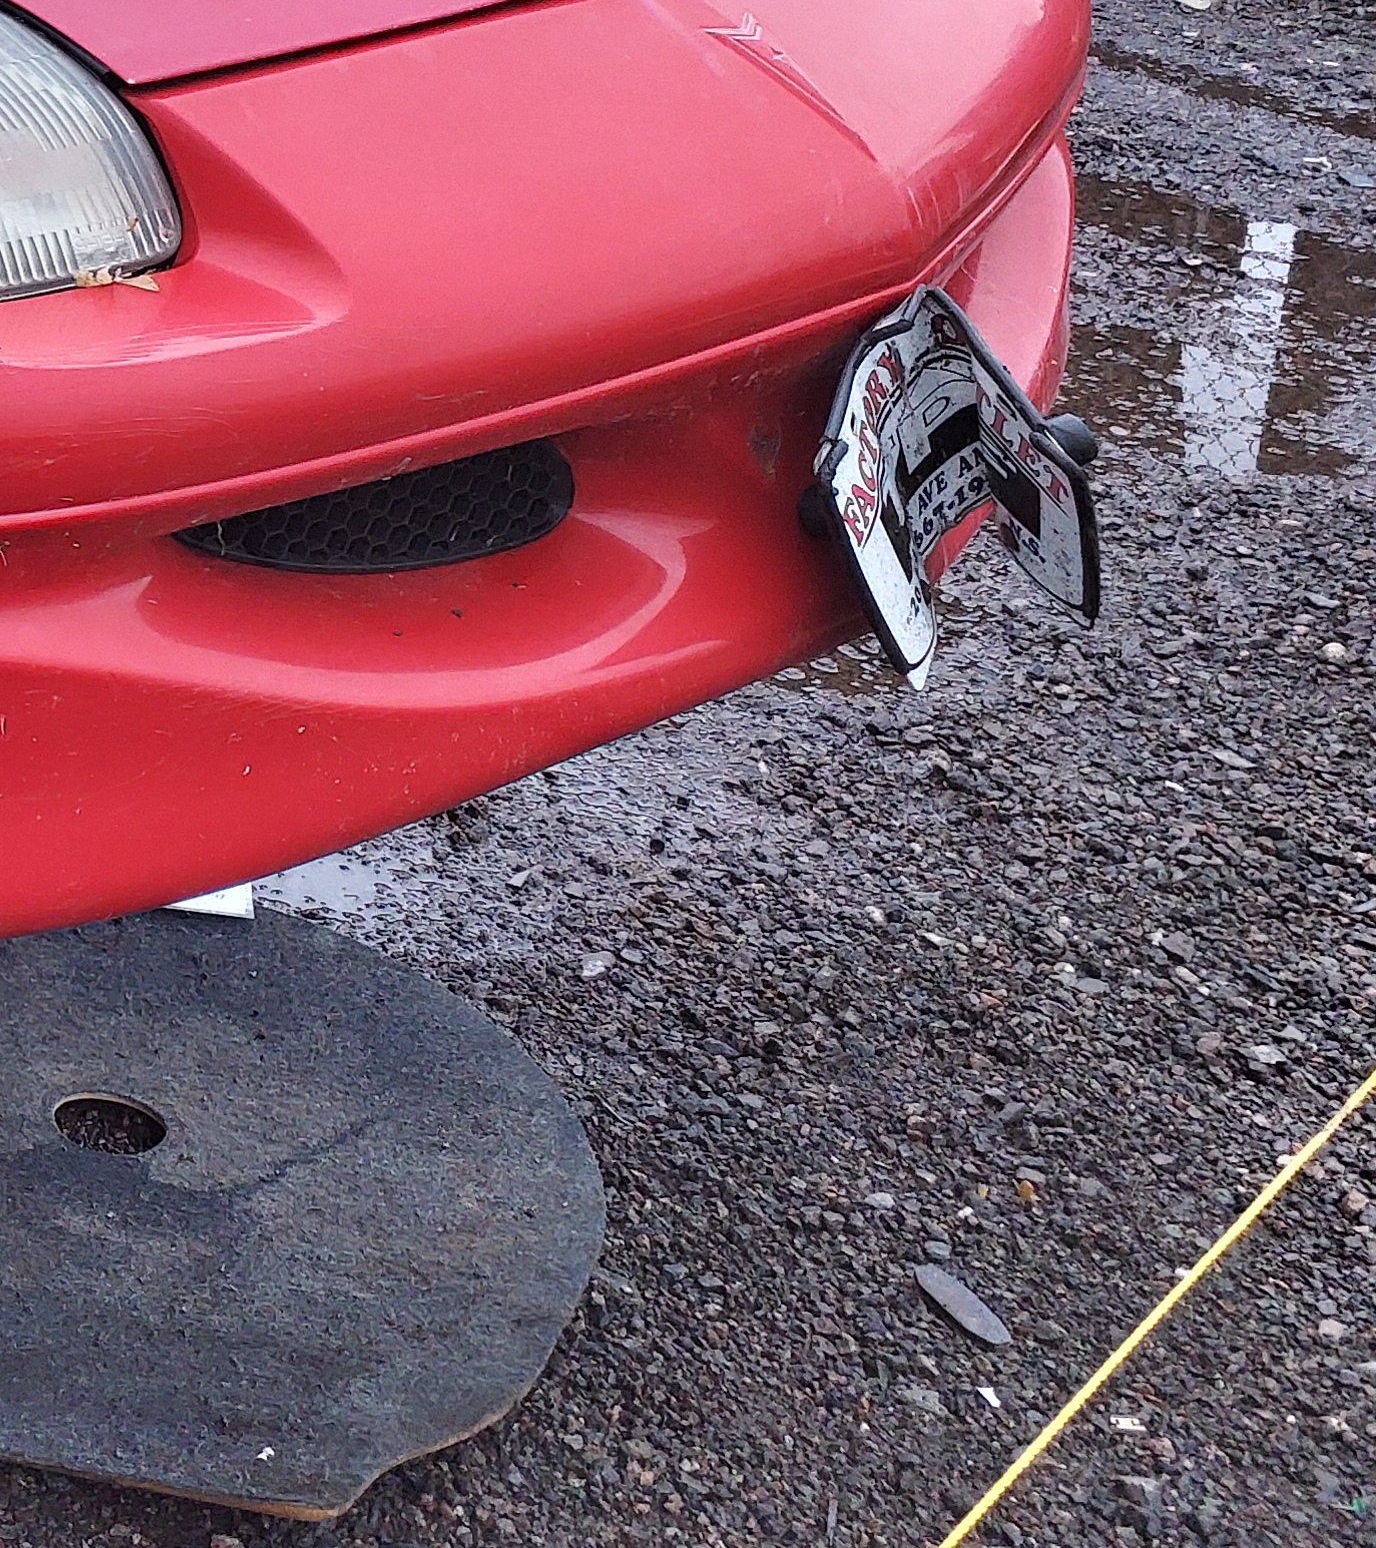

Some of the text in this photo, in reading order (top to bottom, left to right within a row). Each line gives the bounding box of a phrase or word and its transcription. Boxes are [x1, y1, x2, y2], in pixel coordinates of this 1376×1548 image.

[843, 345, 905, 548] FACTORY
[917, 470, 948, 520] AVE
[957, 446, 988, 480] AN
